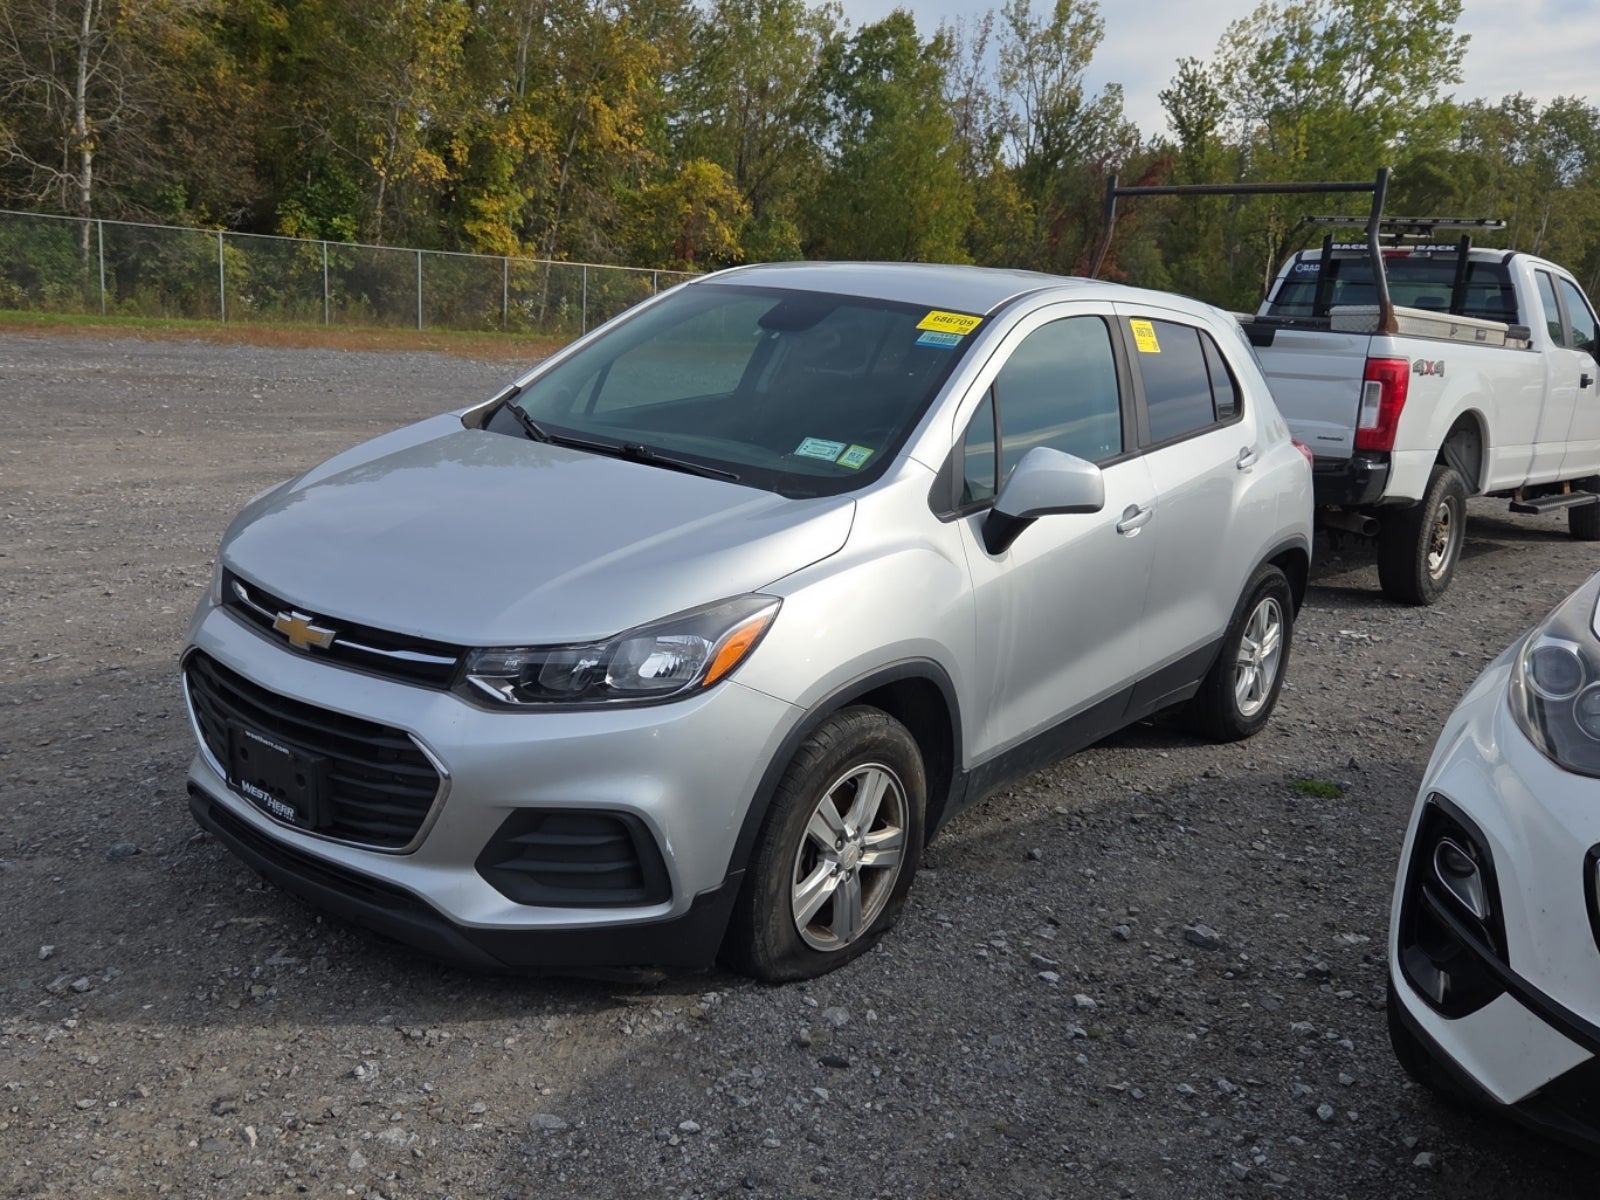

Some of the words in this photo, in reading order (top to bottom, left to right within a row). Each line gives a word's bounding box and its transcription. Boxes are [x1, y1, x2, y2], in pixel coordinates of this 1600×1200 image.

[933, 316, 974, 326] 686709
[241, 780, 270, 800] WEST
[267, 798, 294, 817] HERR
